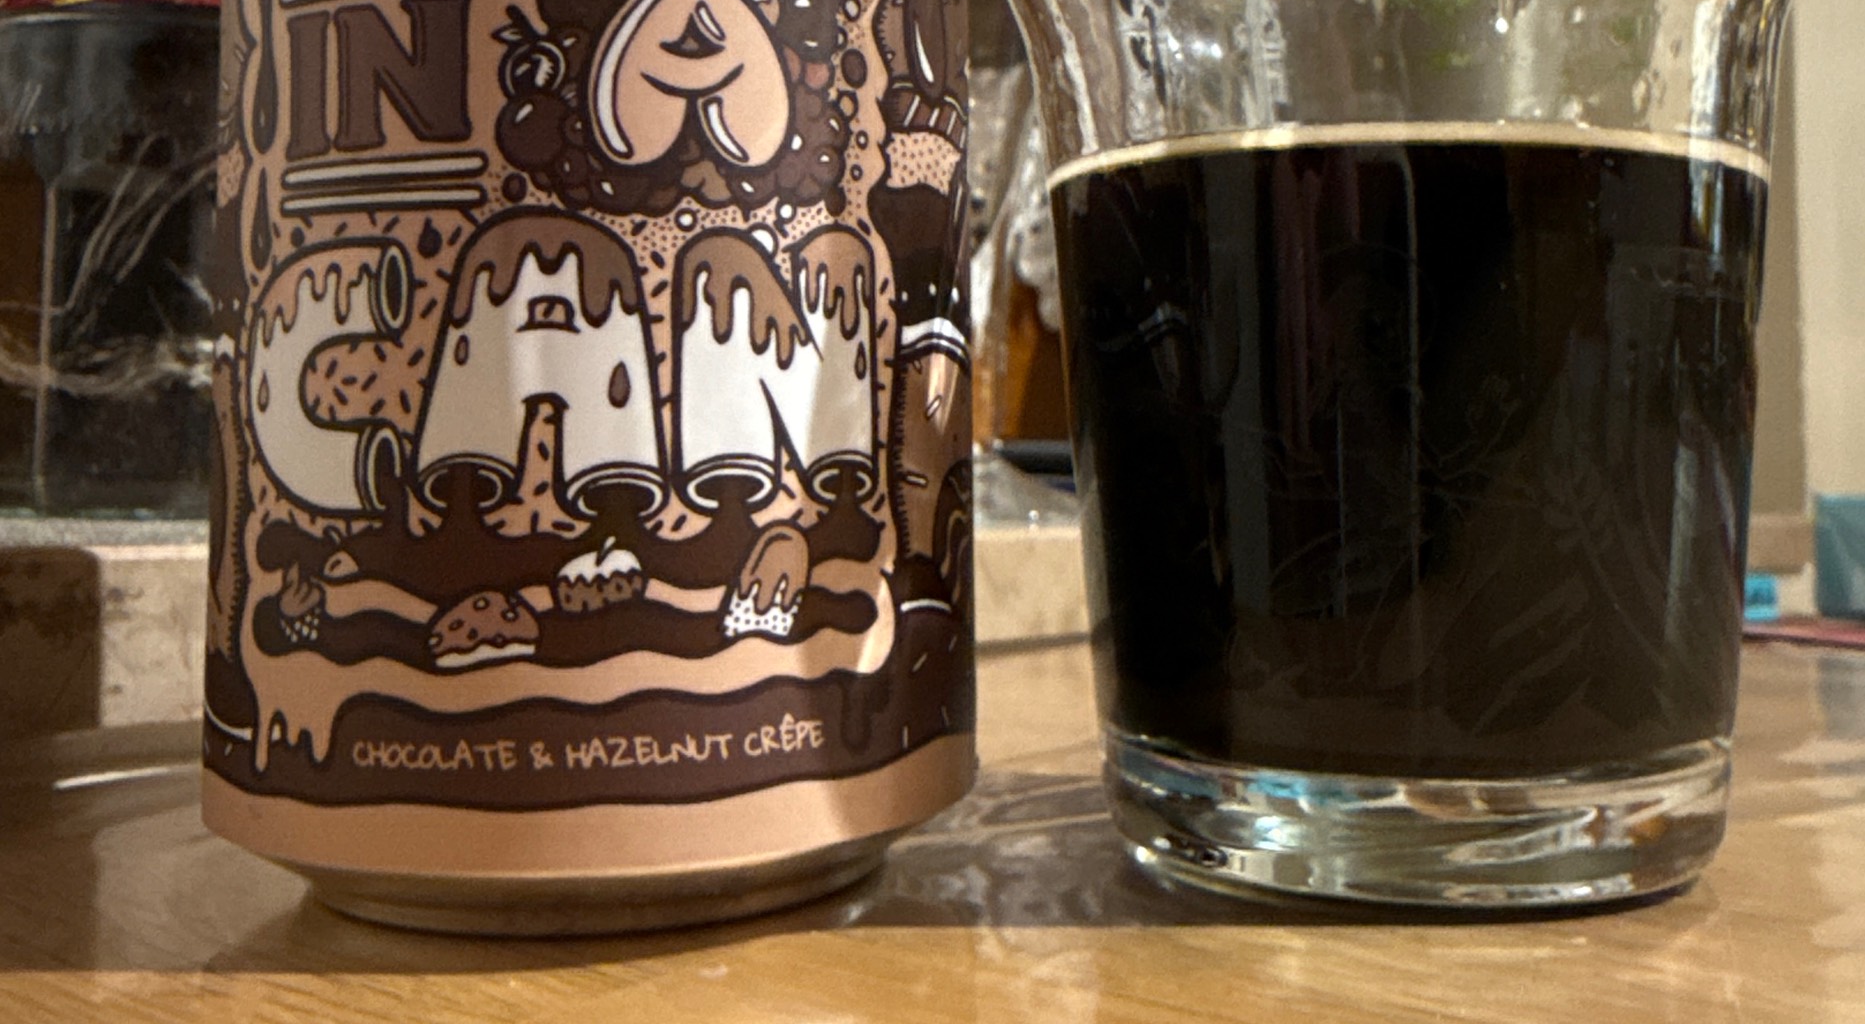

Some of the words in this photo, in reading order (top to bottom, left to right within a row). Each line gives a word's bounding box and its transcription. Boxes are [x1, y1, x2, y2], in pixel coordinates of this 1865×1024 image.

[248, 206, 878, 518] CAN
[352, 739, 517, 771] CHOCOLATE
[529, 740, 554, 769] &
[565, 733, 733, 769] HAZELNUT
[743, 712, 825, 758] CRÊPE
